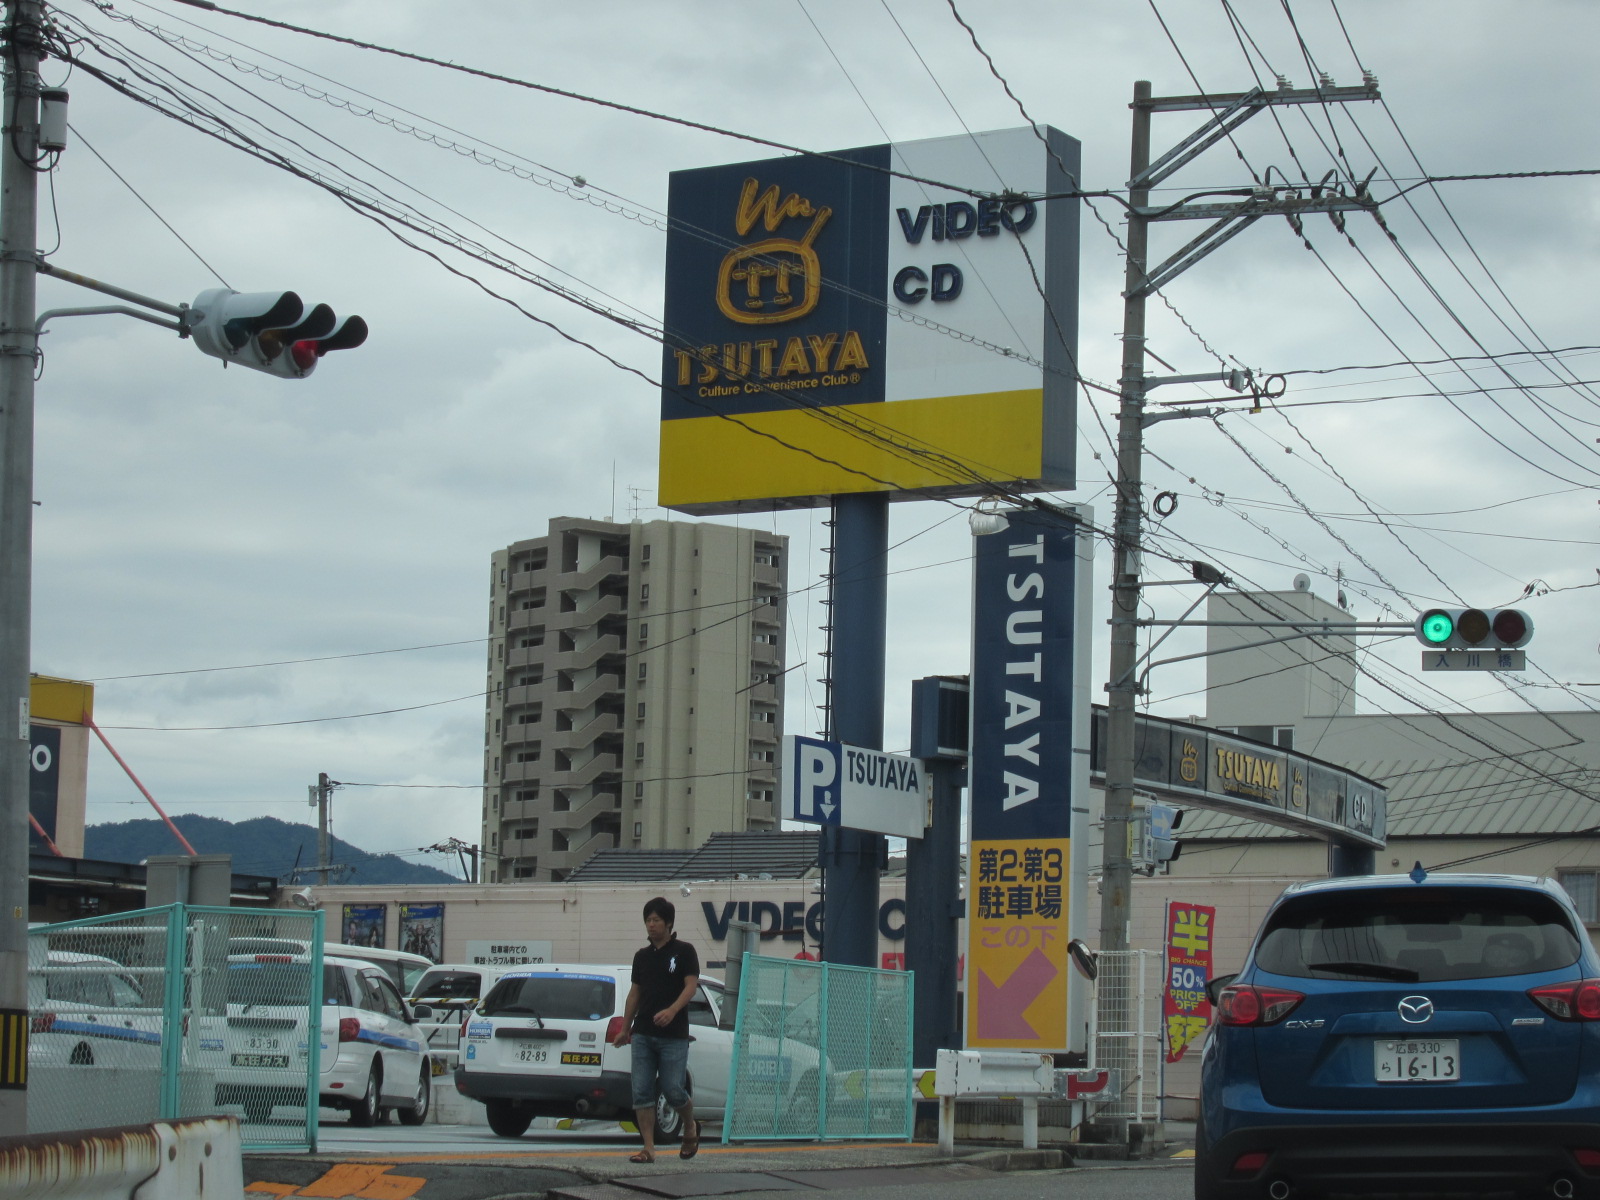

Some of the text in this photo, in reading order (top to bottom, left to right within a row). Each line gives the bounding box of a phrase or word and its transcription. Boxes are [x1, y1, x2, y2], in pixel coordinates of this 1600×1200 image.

[896, 199, 1037, 244] VIDEO
[893, 264, 963, 305] CD
[674, 331, 869, 386] TSUTAYA
[699, 384, 740, 397] Culture
[1003, 534, 1044, 811] TSUTAYA
[847, 749, 919, 793] TSUTAYA
[1216, 748, 1279, 790] TSUTAYA
[978, 884, 1062, 919] 駐車場
[981, 925, 1058, 949] この下
[1171, 909, 1210, 957] 半
[491, 945, 527, 954] 駐車場内での
[1170, 956, 1207, 967] BIG CHANCE
[1172, 967, 1204, 988] 50%
[1170, 988, 1206, 1002] PRICE
[1175, 1000, 1199, 1011] OFF
[1284, 1019, 1325, 1029] CX-5
[562, 1053, 600, 1064] 高圧ガス
[1381, 1056, 1454, 1077] ら 16-13
